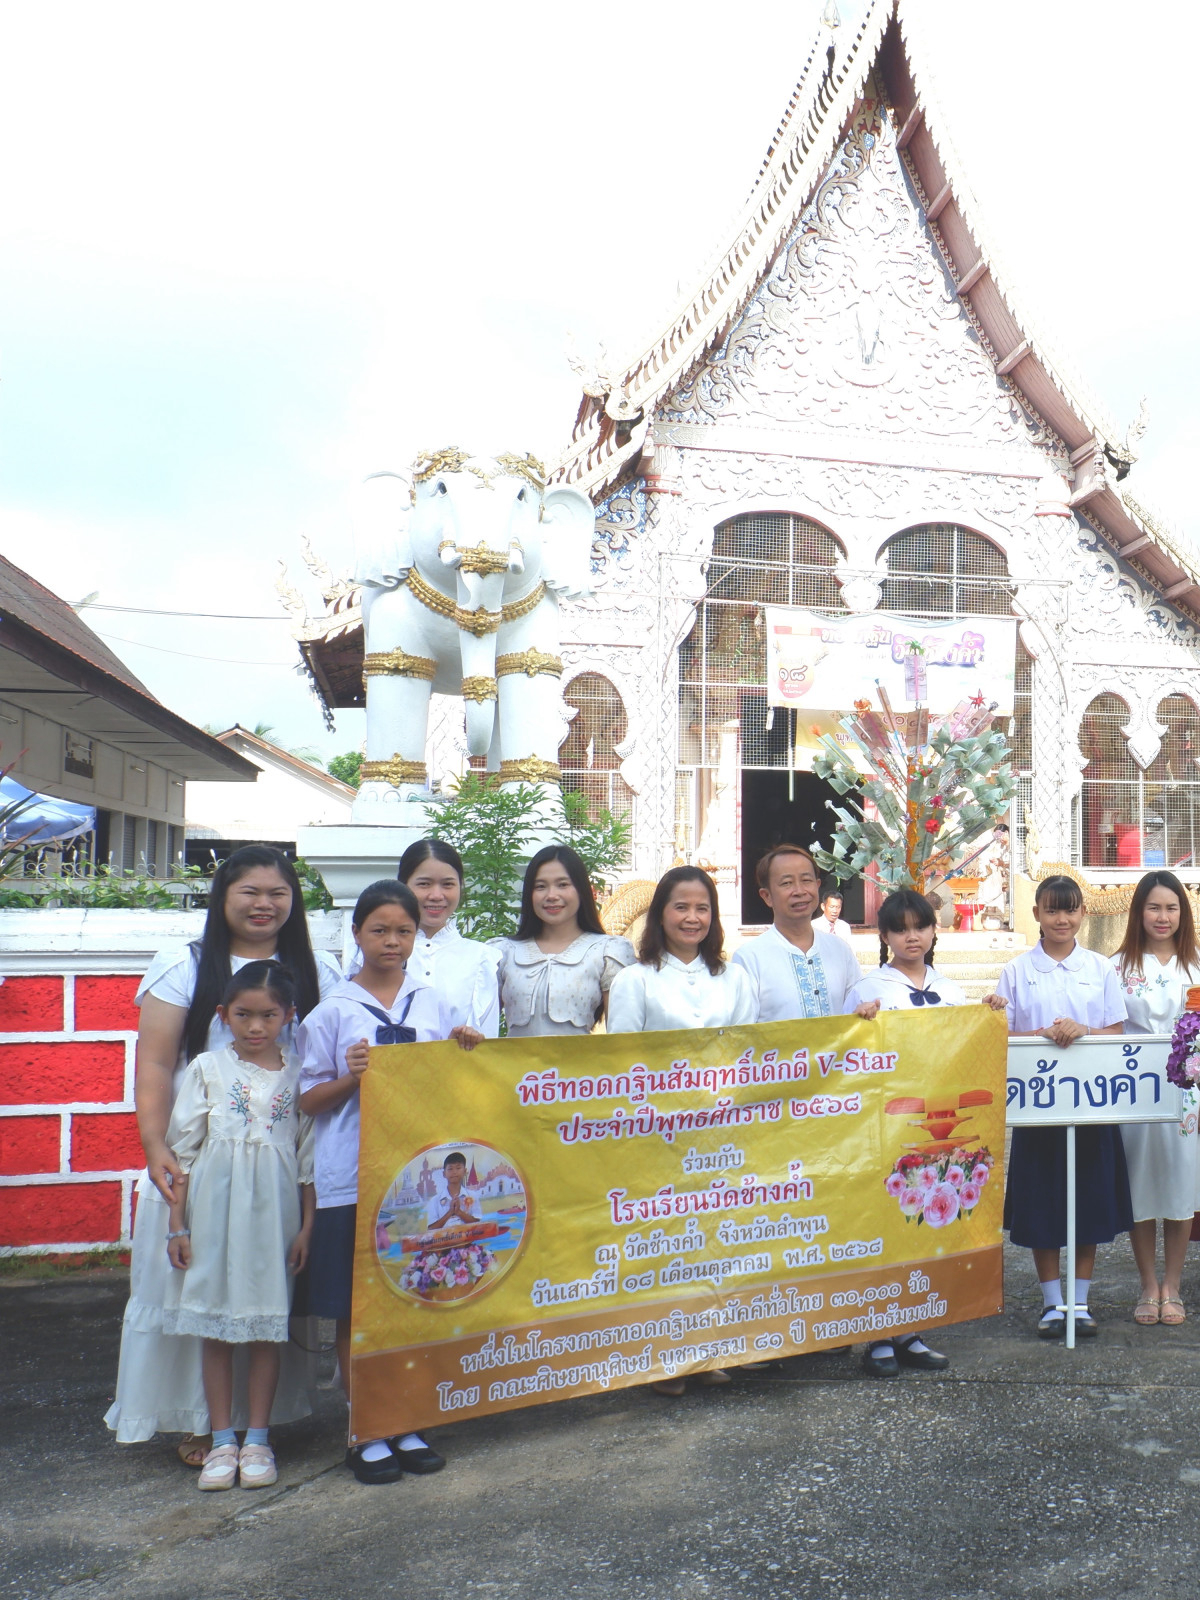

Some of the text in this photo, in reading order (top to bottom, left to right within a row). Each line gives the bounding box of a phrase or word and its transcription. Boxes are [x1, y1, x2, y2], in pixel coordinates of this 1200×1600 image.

[778, 664, 808, 682] ๑๘
[517, 1049, 897, 1104] พิธีทอดกฐินสัมฤทธิ์เด็กดี V-Star
[558, 1095, 860, 1143] ประจำปีพุทธศักราช ๒๕๖๘
[683, 1146, 743, 1172] ร่วมกับ
[609, 1162, 812, 1224] โรงเรียนวัดช้างค้ำ
[597, 1215, 828, 1263] ณ วัดช้างค้ำ จังหวัดลำพูน
[532, 1240, 881, 1305] วันเสาร์ที่ ๑๘ เดือนตุลาคม พ.ศ. ๒๕๖๘
[461, 1271, 930, 1373] หนึ่งในโครงการทอดกฐินสามัคคีทั่วไทย ๓๐,๐๐๐ วัด
[438, 1294, 947, 1409] โดย คณะศิษยานุศิษย์ บูชาธรรม ๘๑ ปี หลวงพ่อธัมมชโย
